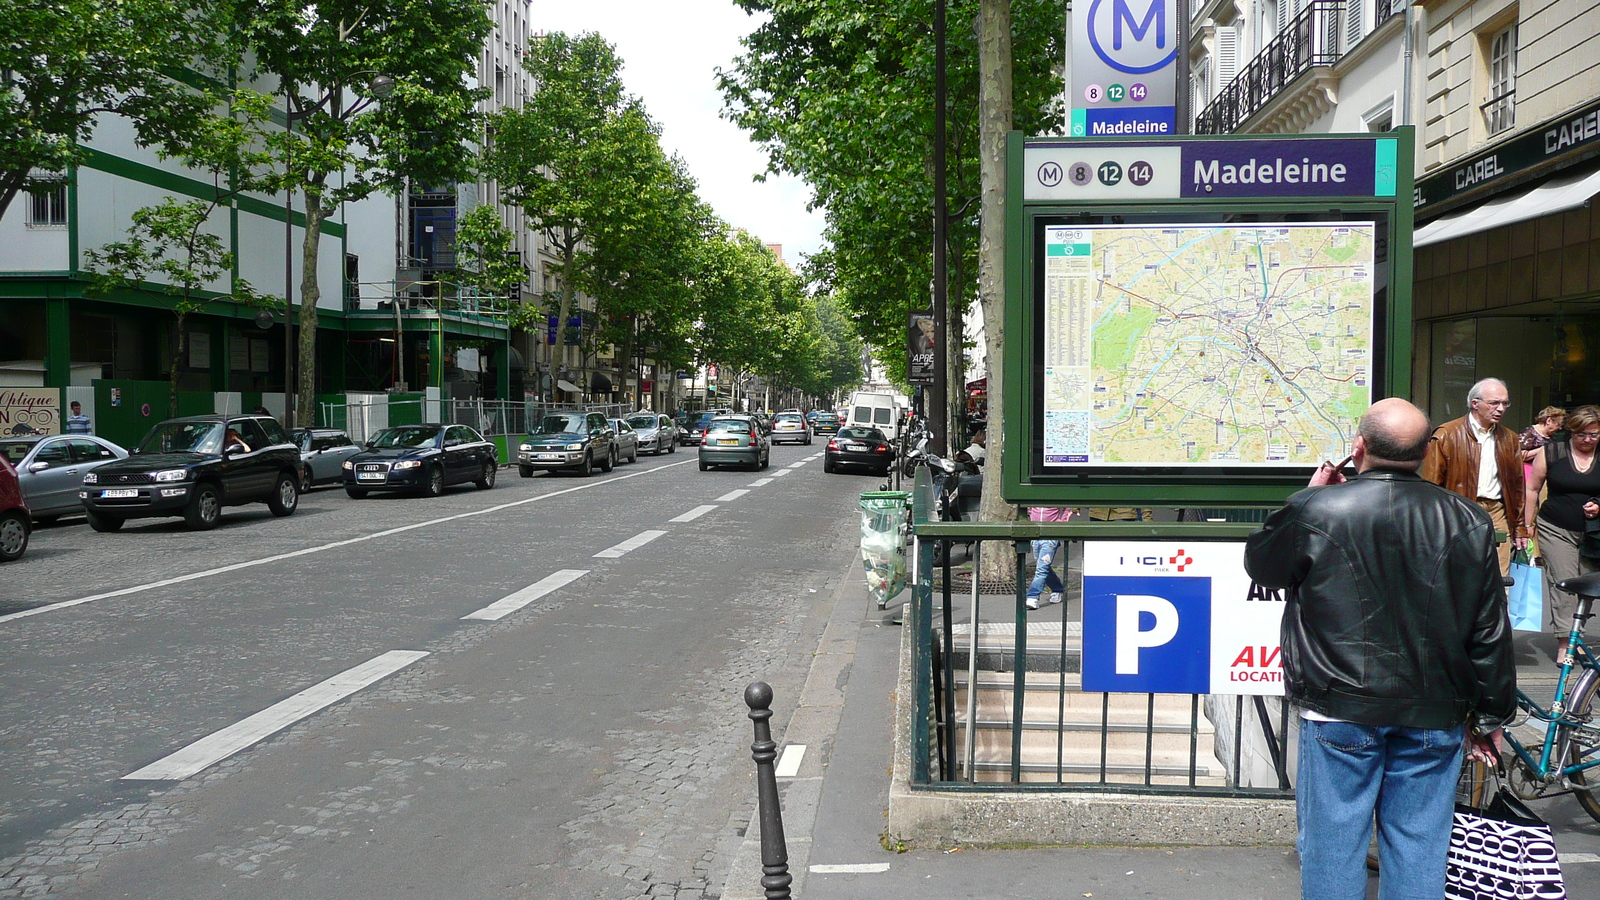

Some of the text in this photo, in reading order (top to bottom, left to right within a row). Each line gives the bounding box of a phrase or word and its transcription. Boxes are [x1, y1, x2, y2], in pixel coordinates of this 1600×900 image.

[1113, 0, 1165, 50] M
[1090, 87, 1145, 99] 8 12 14
[1093, 120, 1168, 135] Madeleine
[1075, 167, 1086, 182] 8
[1100, 166, 1120, 182] 12
[1130, 166, 1150, 181] 14
[1194, 158, 1348, 184] Madeleine
[1456, 155, 1504, 190] CAREL
[1115, 594, 1180, 675] P
[1230, 671, 1282, 682] LOCATI
